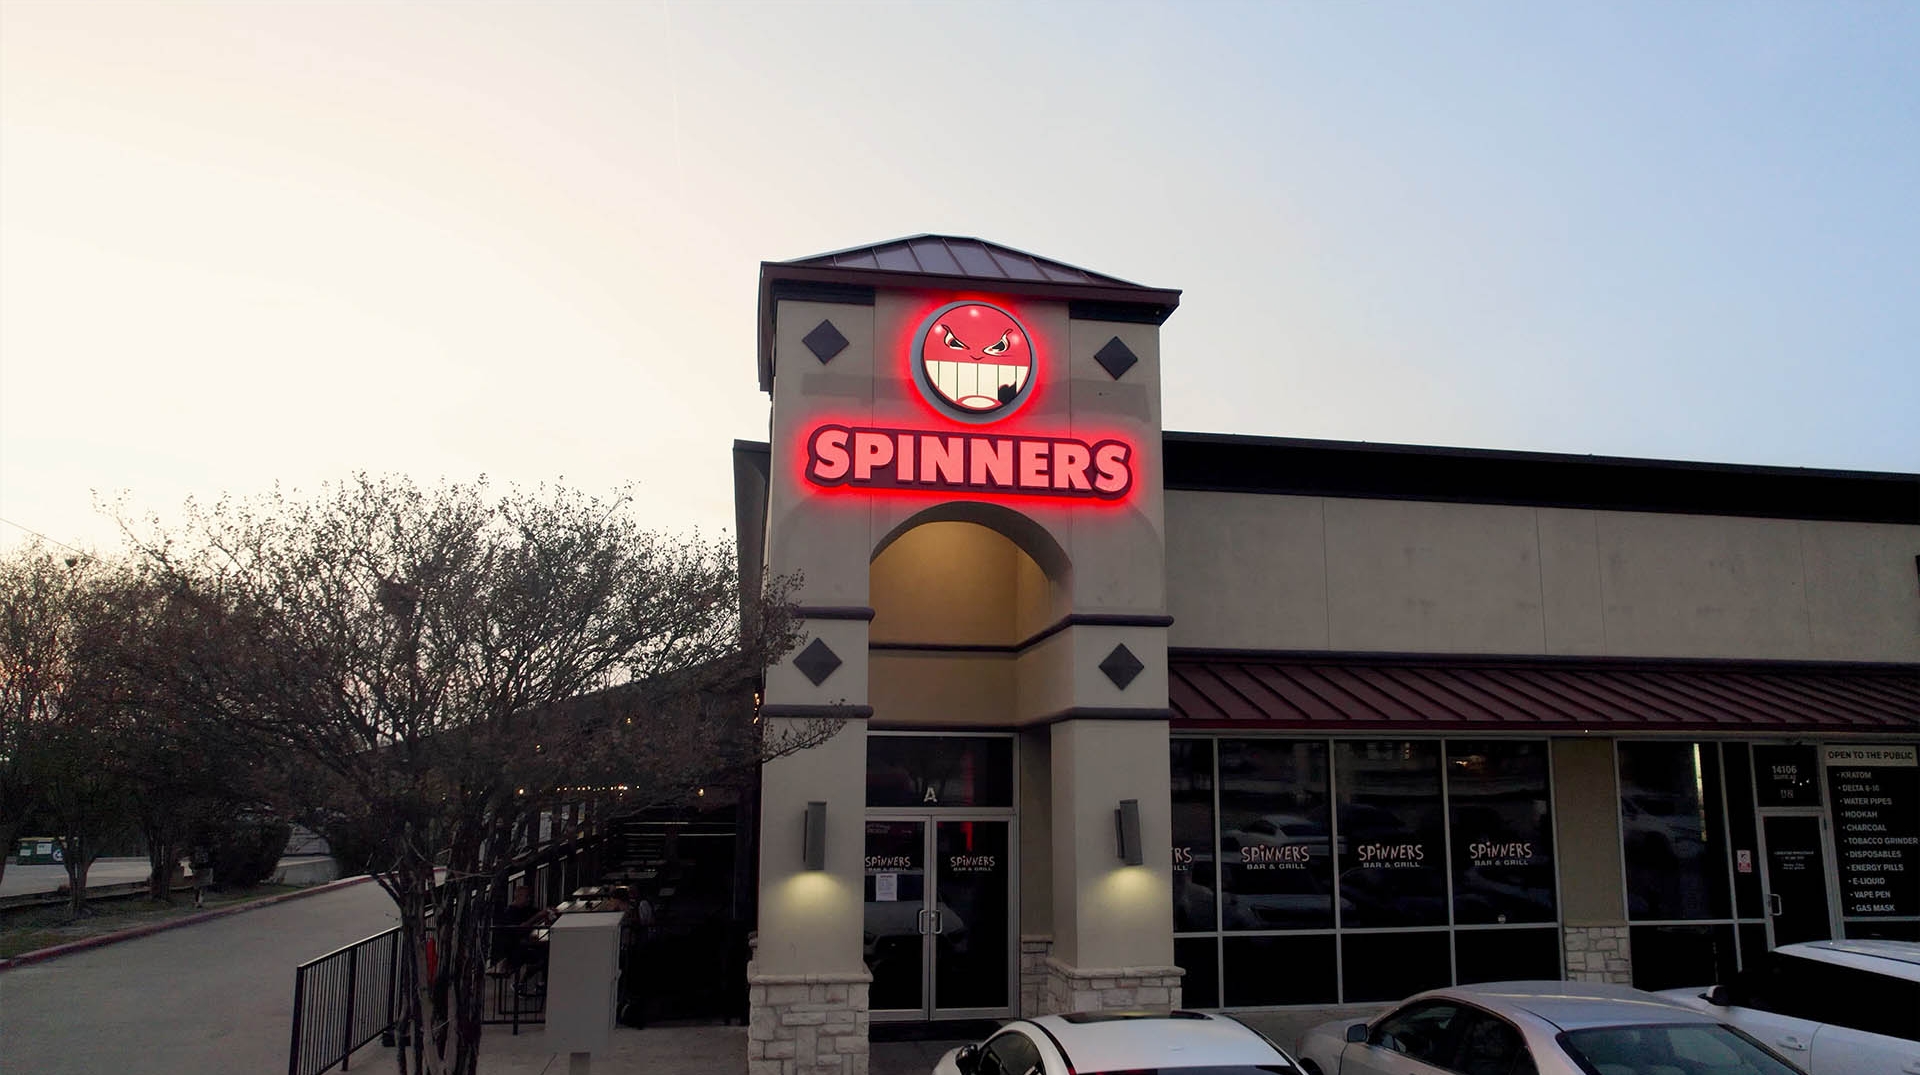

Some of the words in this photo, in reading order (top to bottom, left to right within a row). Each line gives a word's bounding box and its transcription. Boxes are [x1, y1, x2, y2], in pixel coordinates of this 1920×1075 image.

[812, 428, 1130, 494] SPINNERS
[1828, 751, 1851, 759] OPEN
[1854, 751, 1864, 759] TO
[1866, 751, 1882, 759] THE
[1883, 751, 1913, 759] PUBLIC
[1771, 765, 1798, 774] 14106
[1840, 771, 1872, 779] KRATOM
[1842, 784, 1864, 792] DELTA
[923, 787, 938, 802] A
[1843, 797, 1869, 805] WATER
[1870, 797, 1893, 805] PIPES
[1845, 810, 1878, 819] HOOKAH
[1846, 824, 1888, 832] CHARCOAL
[1848, 837, 1883, 845] TOBACCO
[1884, 837, 1919, 845] GRINDER
[1171, 847, 1193, 863] RS
[1849, 850, 1902, 858] DISPOSABLES
[1852, 877, 1886, 885] E-LIQUID
[1854, 890, 1874, 898] VAPE
[1875, 890, 1891, 898] PEN
[1856, 904, 1872, 912] GAS
[1873, 904, 1896, 912] MASK
